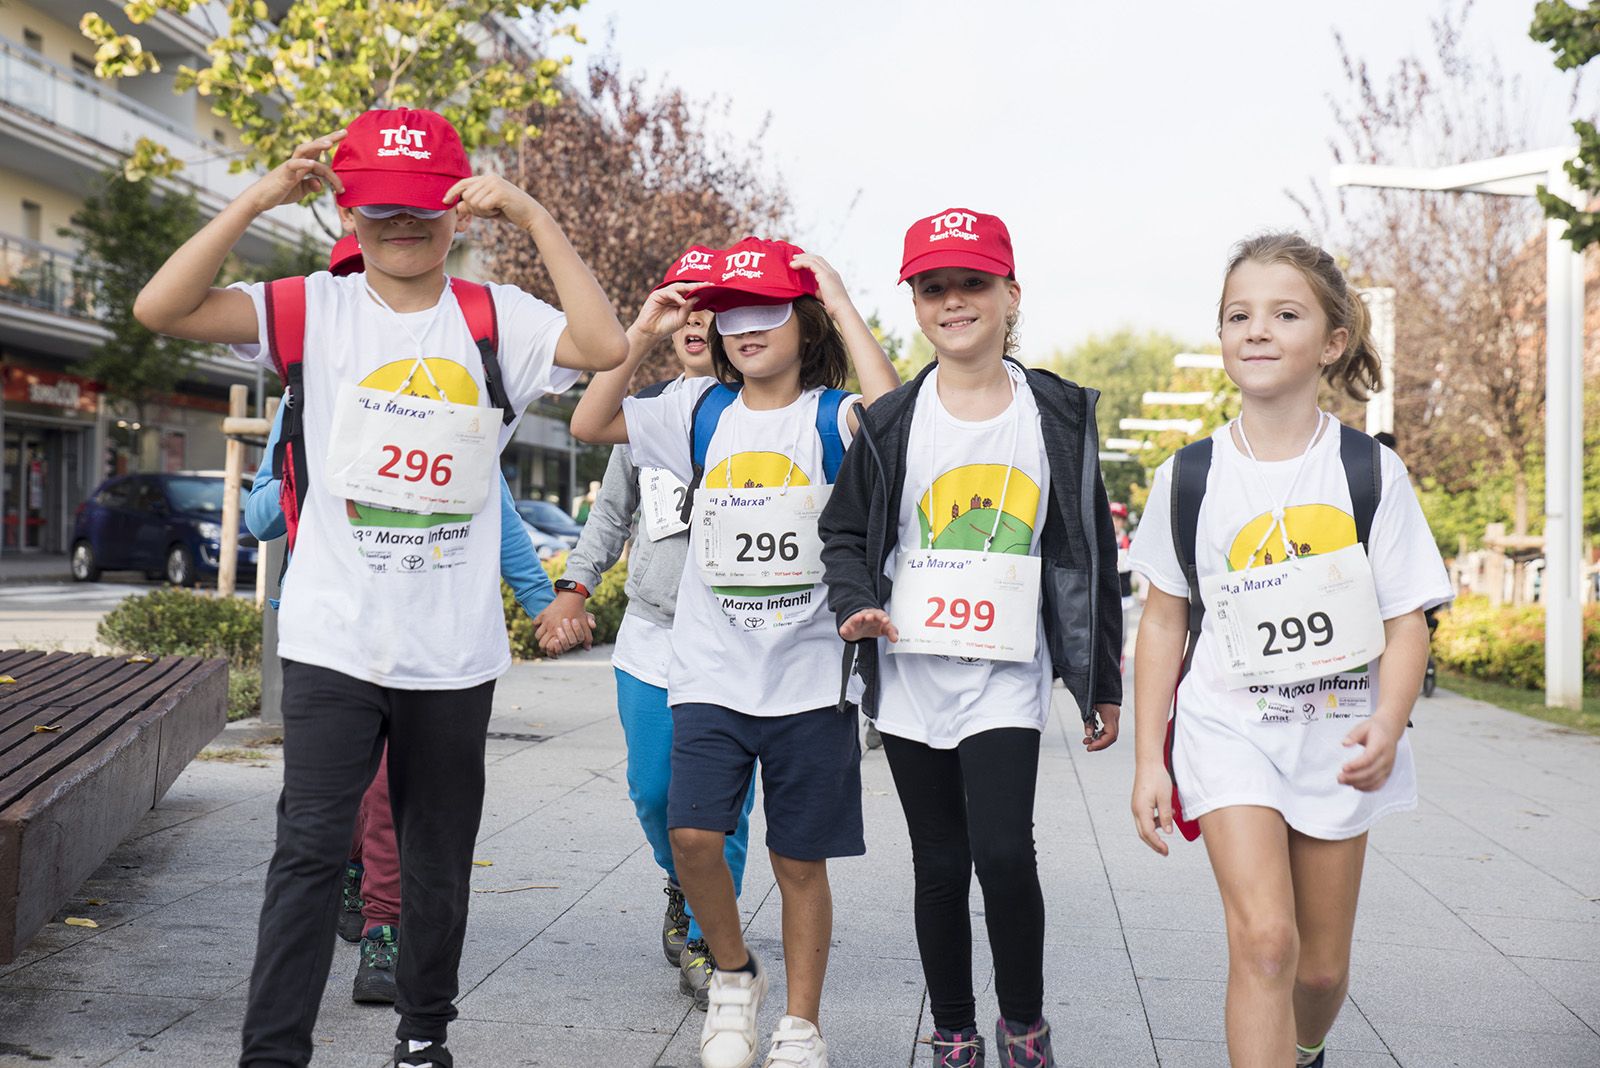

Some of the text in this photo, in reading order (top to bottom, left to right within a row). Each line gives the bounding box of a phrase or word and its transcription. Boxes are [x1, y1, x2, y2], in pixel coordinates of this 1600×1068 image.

[380, 125, 426, 147] TOT
[931, 212, 977, 233] TOT
[680, 250, 714, 268] TOT
[726, 251, 766, 271] TOT
[377, 445, 454, 486] 296
[375, 531, 424, 546] Marxa
[428, 525, 471, 544] Infantil
[736, 532, 799, 562] 296
[721, 591, 812, 611] Marxa Infantil
[924, 596, 995, 632] 299
[1257, 611, 1334, 656] 299
[1278, 683, 1316, 699] Marxa
[1319, 675, 1369, 692] Infantil
